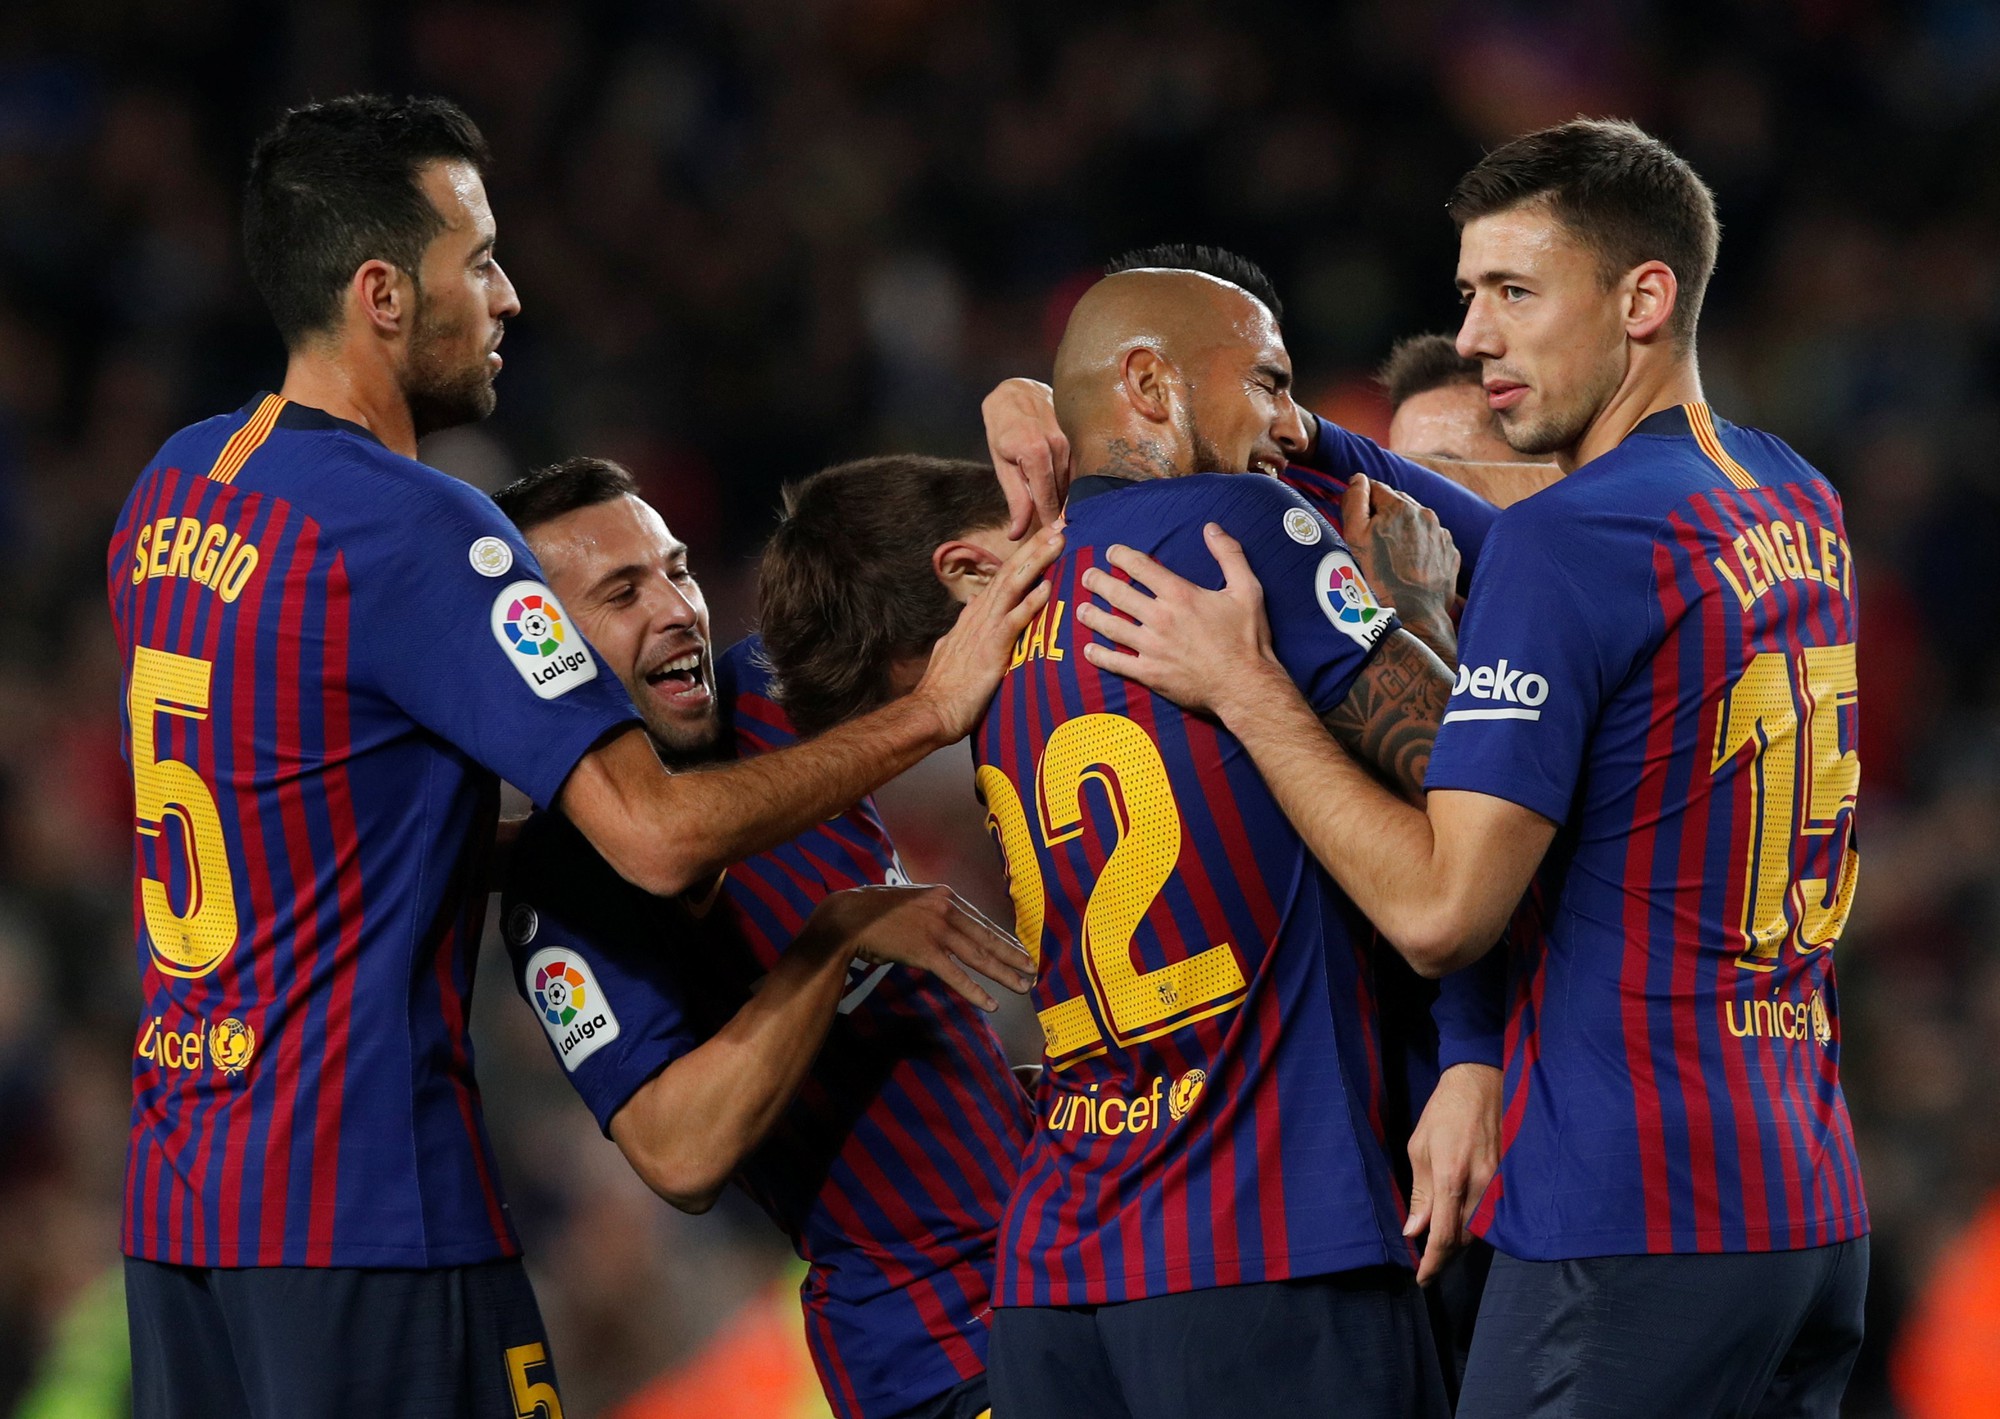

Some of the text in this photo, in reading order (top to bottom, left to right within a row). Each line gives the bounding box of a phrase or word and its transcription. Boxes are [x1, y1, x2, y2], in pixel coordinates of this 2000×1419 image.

[132, 516, 259, 604] SERGIO
[1714, 520, 1852, 613] LENGLET
[531, 651, 587, 685] LaLiga
[1005, 600, 1065, 676] DAL
[127, 645, 239, 979] 5
[1710, 642, 1861, 972] 15
[559, 1014, 607, 1056] LaLiga
[1048, 1076, 1163, 1135] unicef
[504, 1341, 564, 1419] 5
